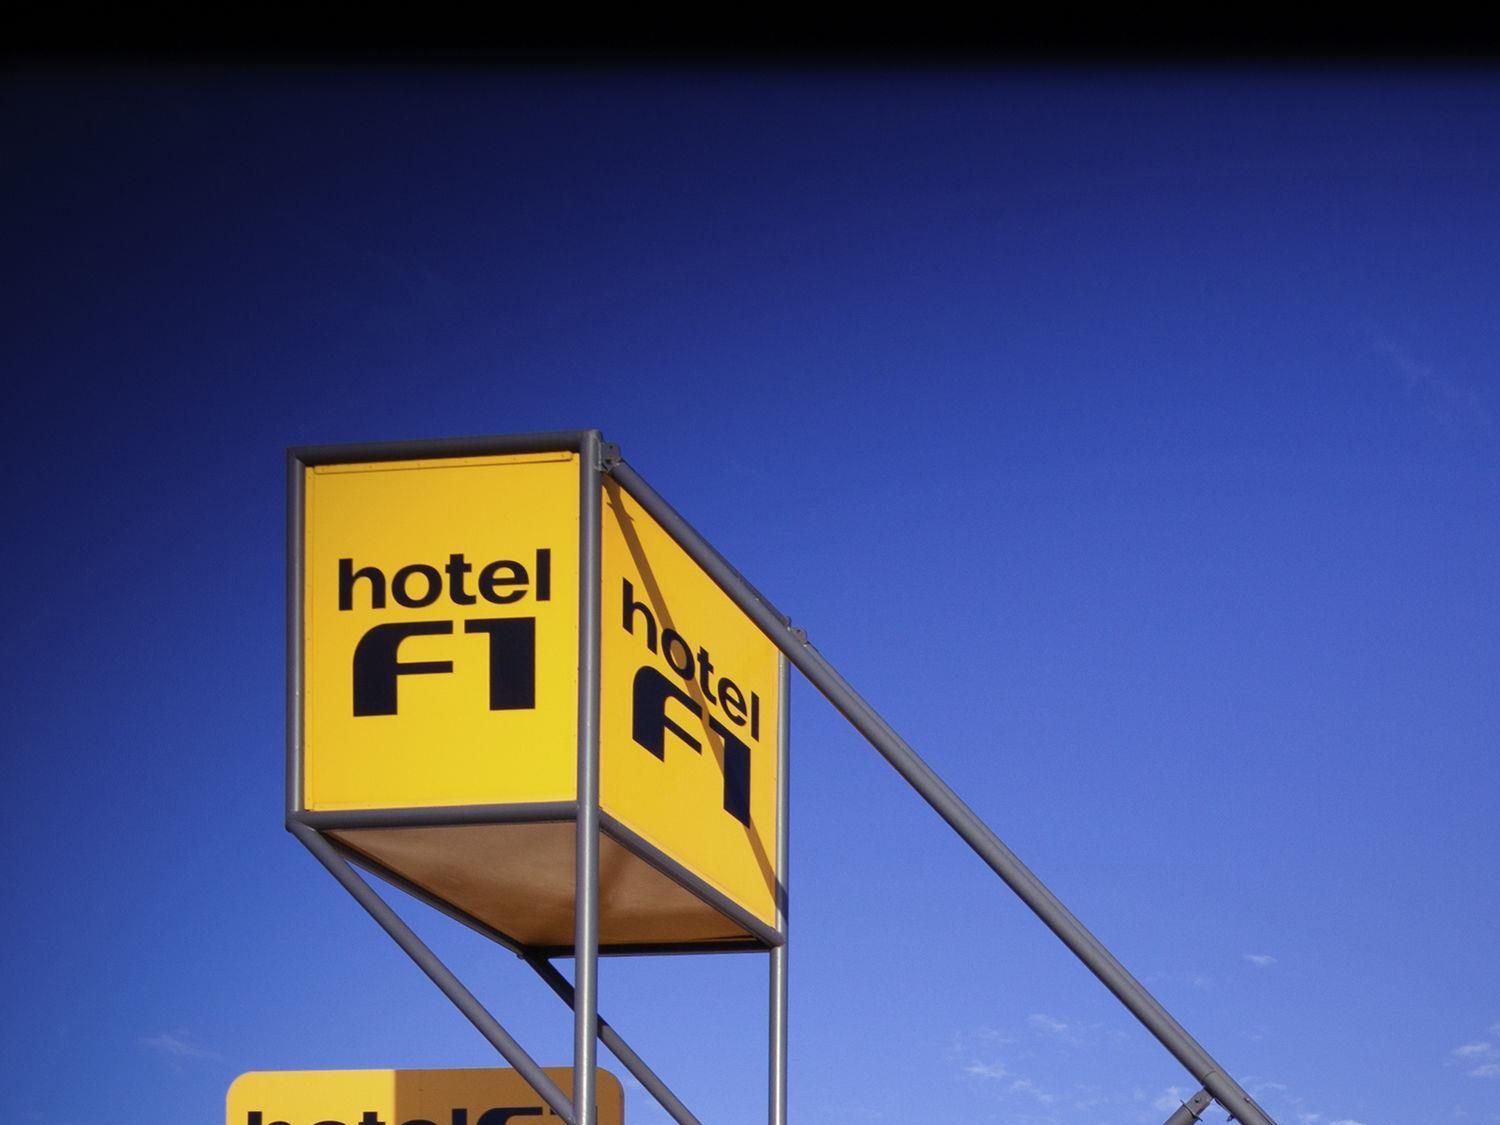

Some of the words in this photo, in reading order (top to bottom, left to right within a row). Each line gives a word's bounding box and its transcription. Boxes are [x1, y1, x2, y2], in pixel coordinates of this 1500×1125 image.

[338, 548, 551, 611] hotel
[352, 616, 536, 717] F1
[621, 577, 760, 742] hotel
[632, 665, 751, 829] F1
